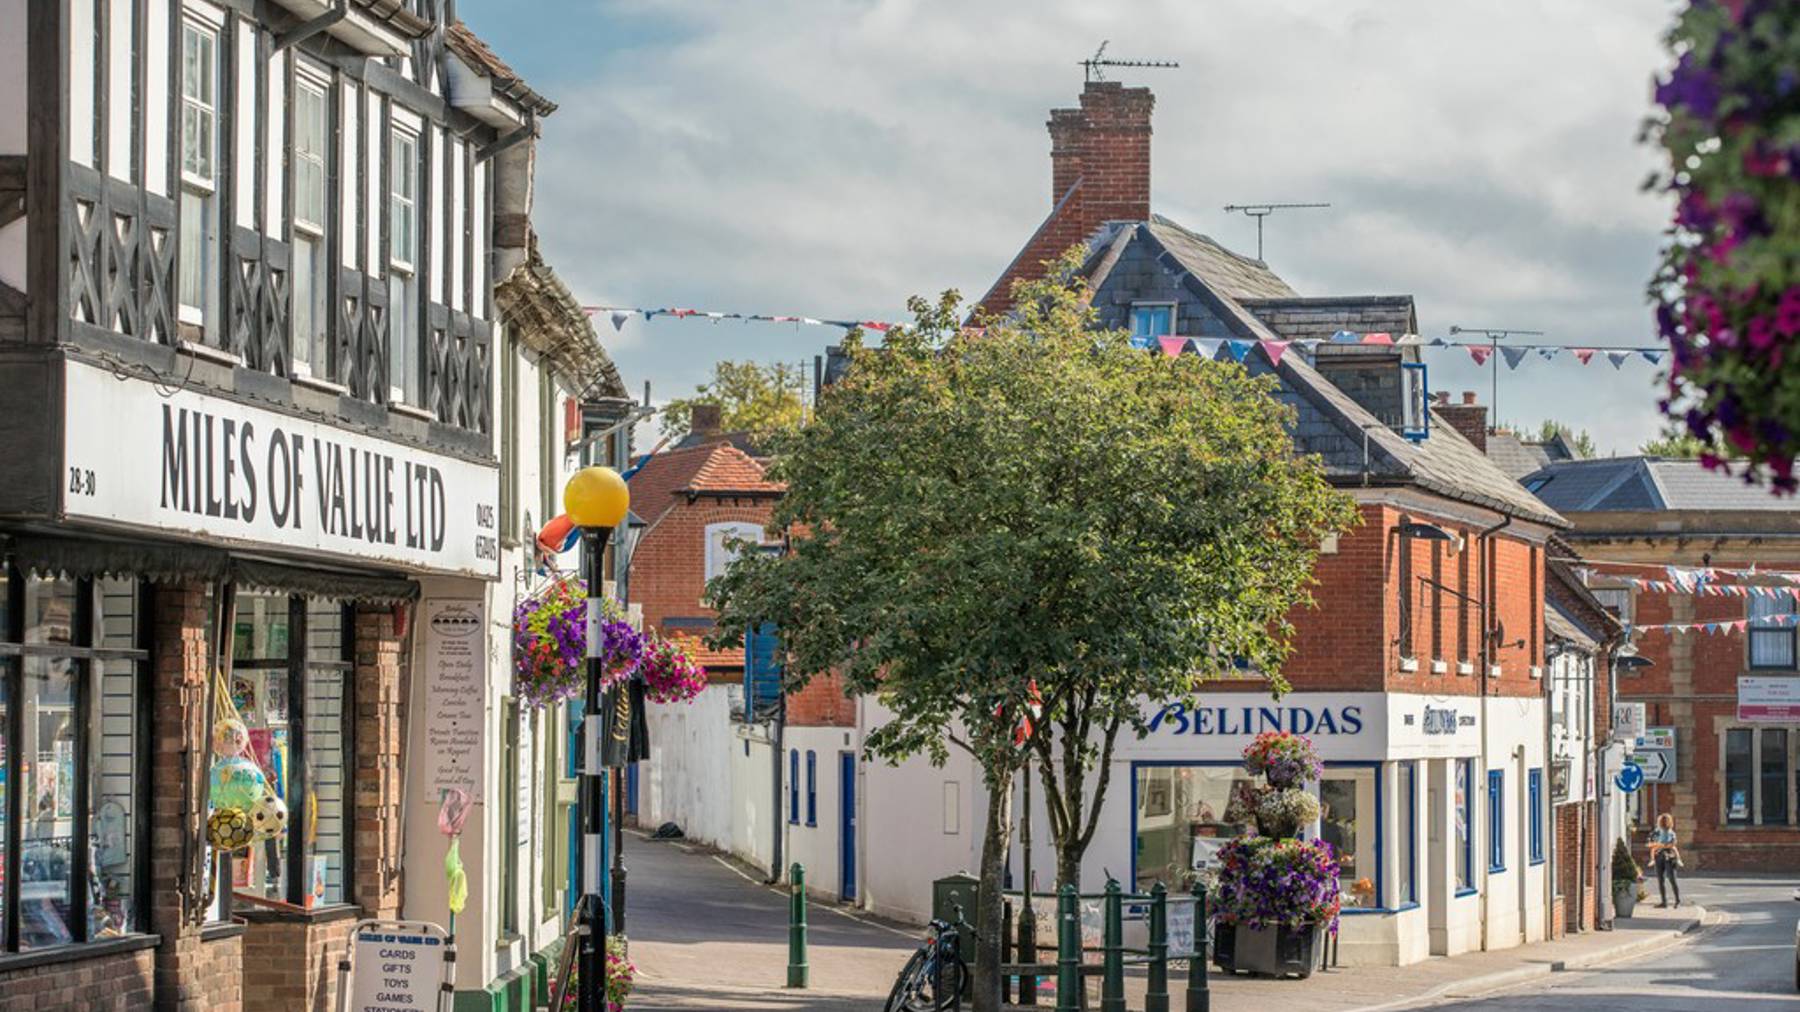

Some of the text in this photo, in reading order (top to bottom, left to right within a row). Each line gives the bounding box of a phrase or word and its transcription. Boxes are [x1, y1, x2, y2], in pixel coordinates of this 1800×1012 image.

[69, 466, 96, 497] 28-30
[160, 403, 446, 553] MILES OF VALUE LTD
[1148, 702, 1362, 735] BELINDAS
[379, 949, 416, 960] CARDS
[382, 964, 411, 974] GIFTS
[383, 978, 409, 989] TOYS
[376, 992, 414, 1004] GAMES
